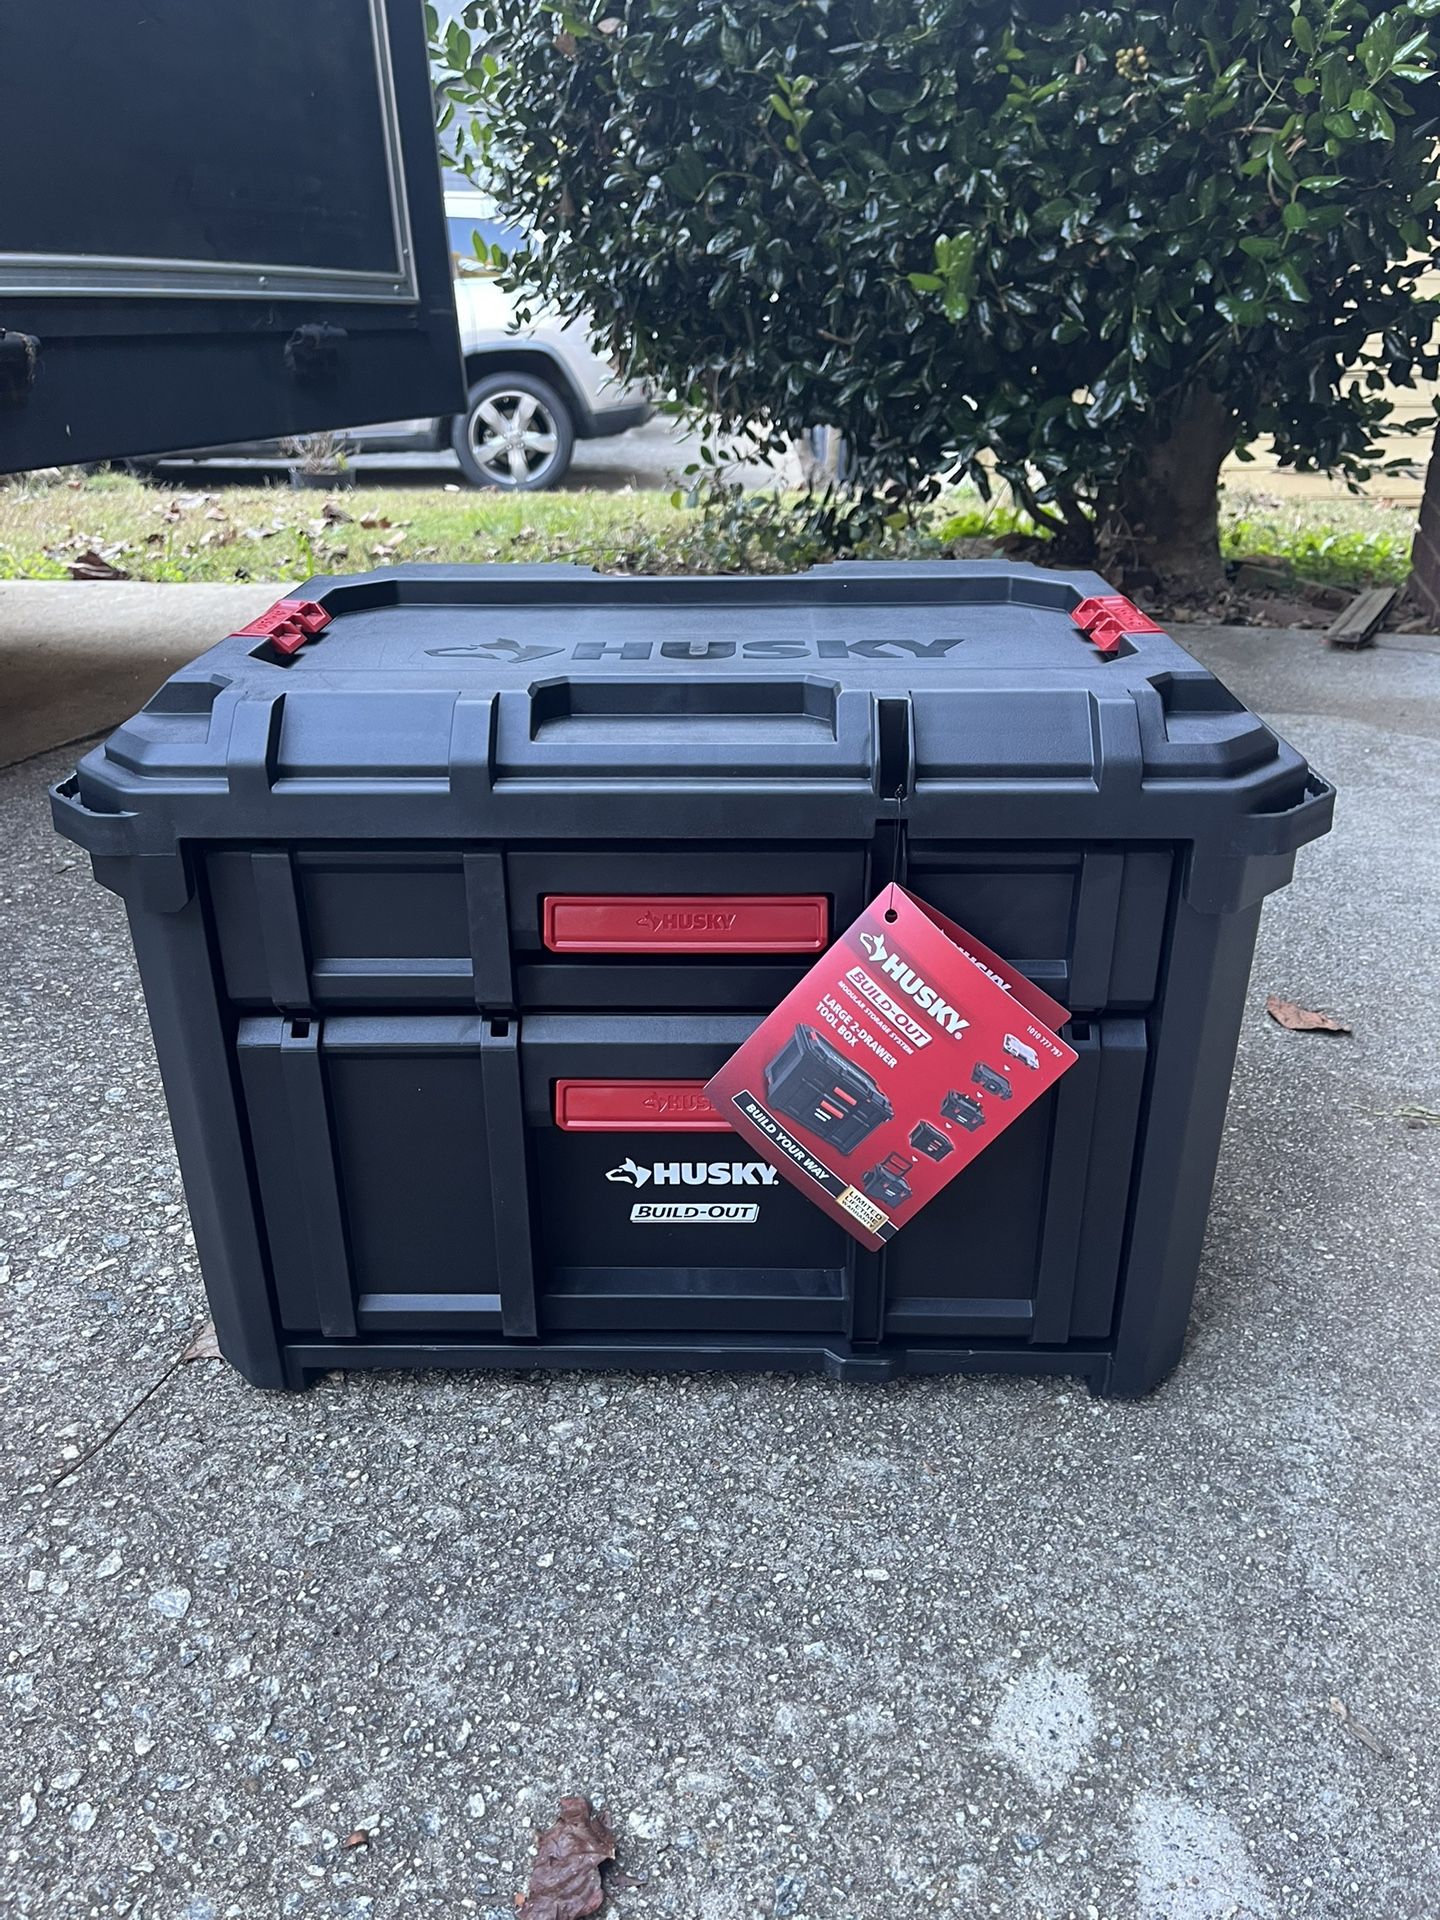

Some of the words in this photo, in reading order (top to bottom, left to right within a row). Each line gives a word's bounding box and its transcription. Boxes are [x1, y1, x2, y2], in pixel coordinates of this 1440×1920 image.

[571, 638, 965, 660] HUSKY
[661, 913, 737, 931] HUSKY
[849, 971, 928, 1043] BUILD-OUT
[881, 953, 970, 1036] HUSKY
[815, 1002, 838, 1028] TOOL
[837, 1026, 859, 1048] BOX
[823, 993, 853, 1025] LARGE
[851, 1021, 898, 1068] 2-DRAWER
[838, 981, 865, 1008] MODULAR
[864, 1007, 890, 1033] STORAGE
[889, 1031, 914, 1055] SYSTEM
[1026, 1025, 1040, 1040] 1010
[745, 1103, 777, 1134] BUILD
[775, 1132, 805, 1161] YOUR
[803, 1157, 830, 1180] WAY
[634, 1206, 754, 1218] BUILD-OUT
[841, 1200, 875, 1229] WARRANTY
[845, 1195, 879, 1225] LIFETIME
[848, 1190, 883, 1221] LIMITED
